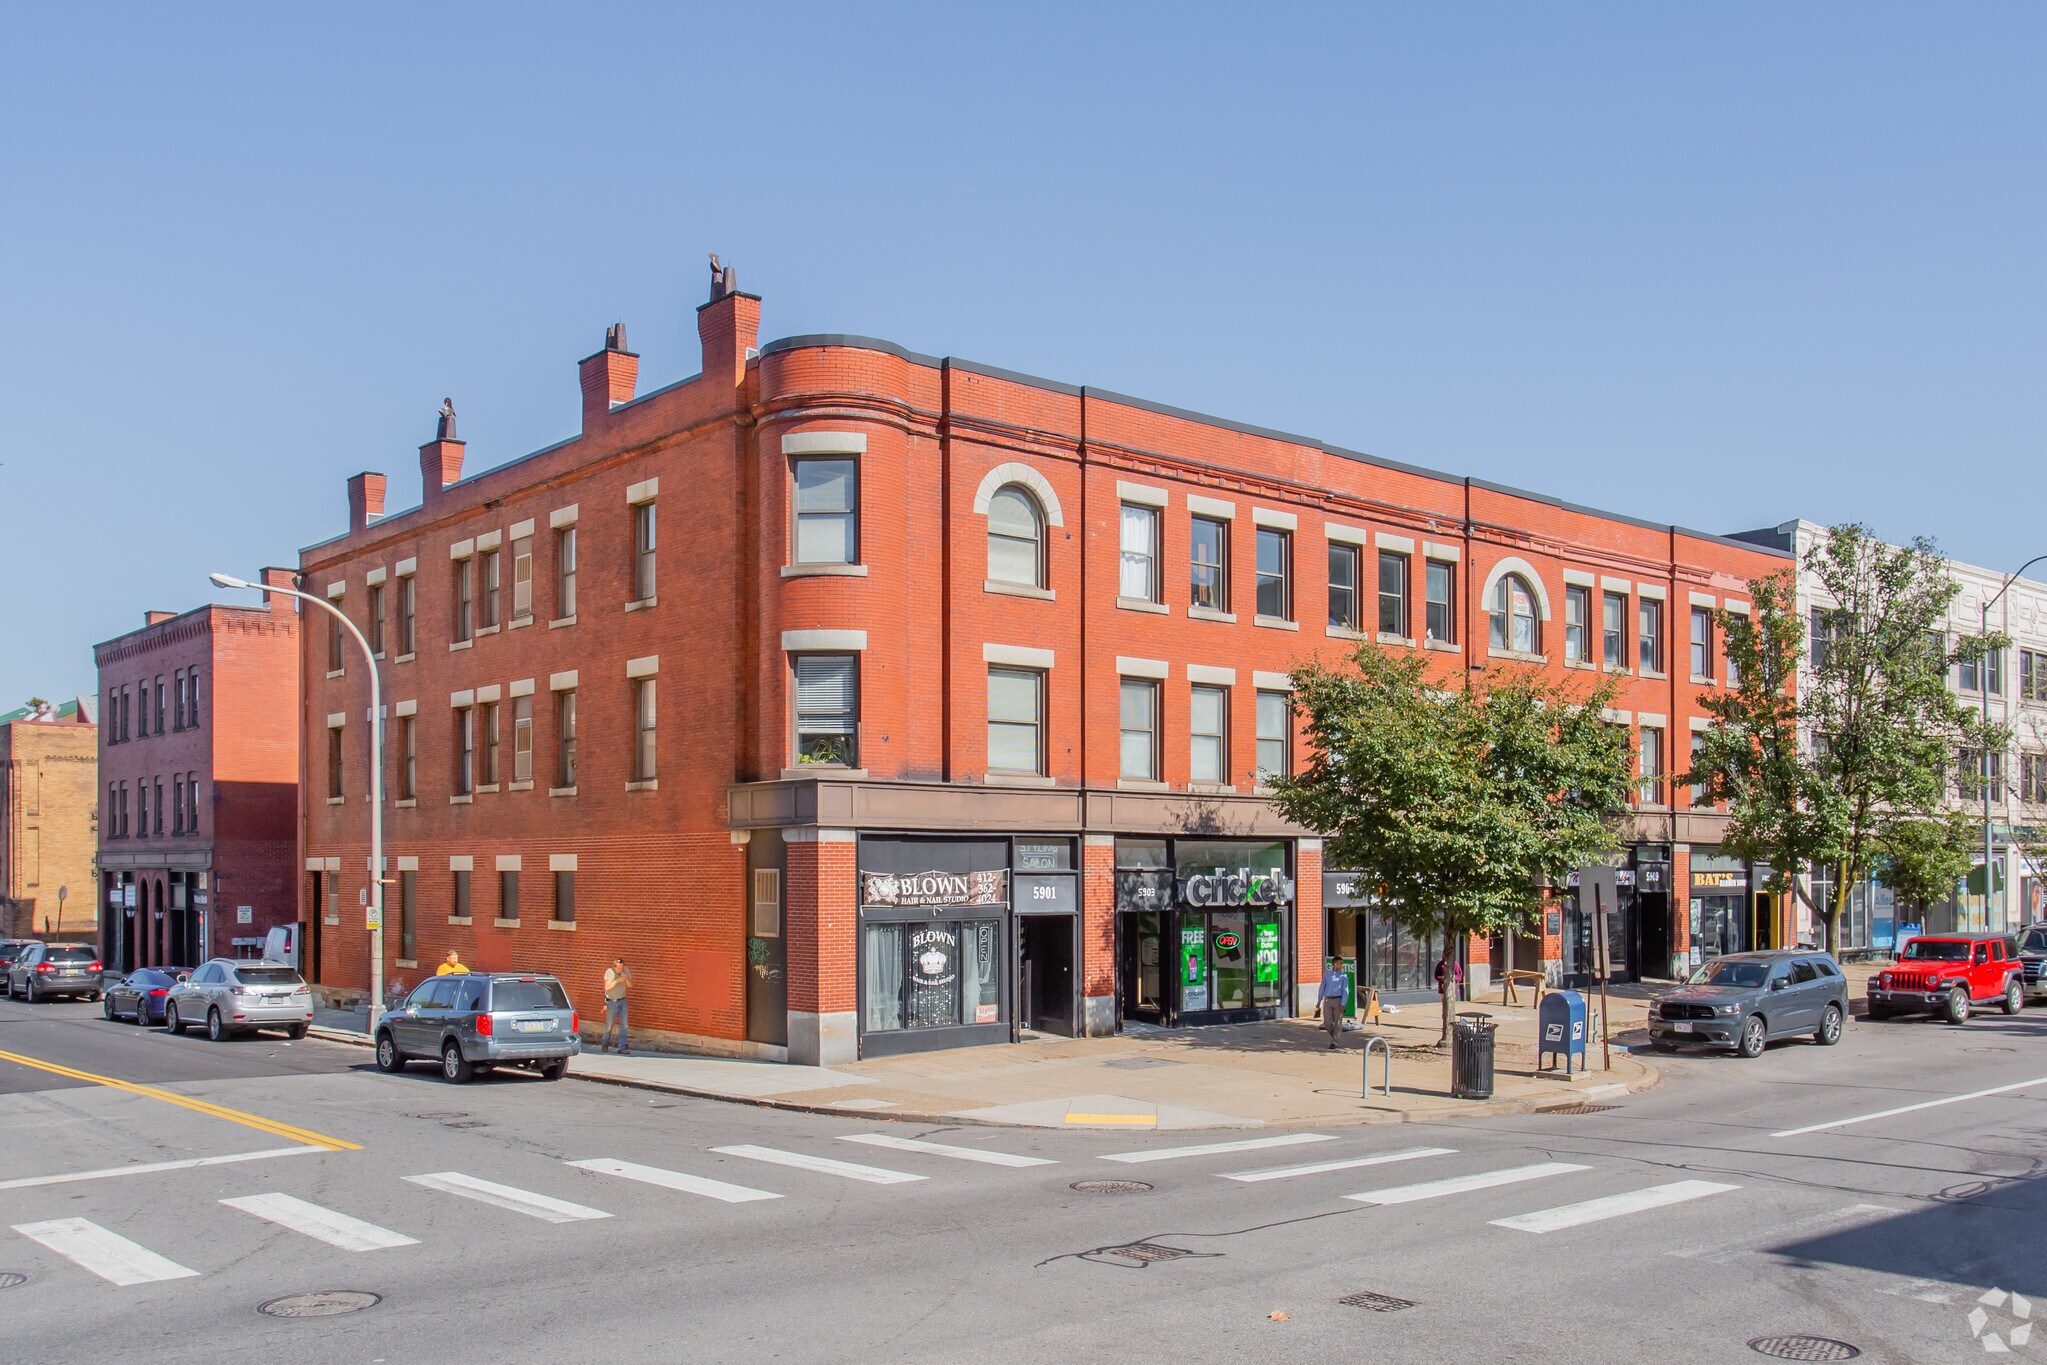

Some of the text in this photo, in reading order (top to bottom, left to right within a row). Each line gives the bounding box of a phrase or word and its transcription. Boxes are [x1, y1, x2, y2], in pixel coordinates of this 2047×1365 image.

[1022, 857, 1056, 869] SALON
[976, 872, 997, 882] 412-
[1694, 872, 1734, 887] BAT'S
[900, 877, 969, 896] BLOWN
[977, 883, 997, 894] 362-
[1137, 887, 1155, 897] 5903
[1186, 868, 1290, 907] cricket
[1033, 886, 1057, 900] 5901
[901, 897, 919, 905] HAIR
[944, 895, 970, 904] STUDIO
[976, 894, 997, 905] 4024
[913, 931, 955, 948] BLOWN
[1181, 930, 1204, 944] FREE
[1219, 936, 1238, 946] OPEN
[980, 928, 988, 961] OPEN
[1326, 962, 1355, 973] GTIS
